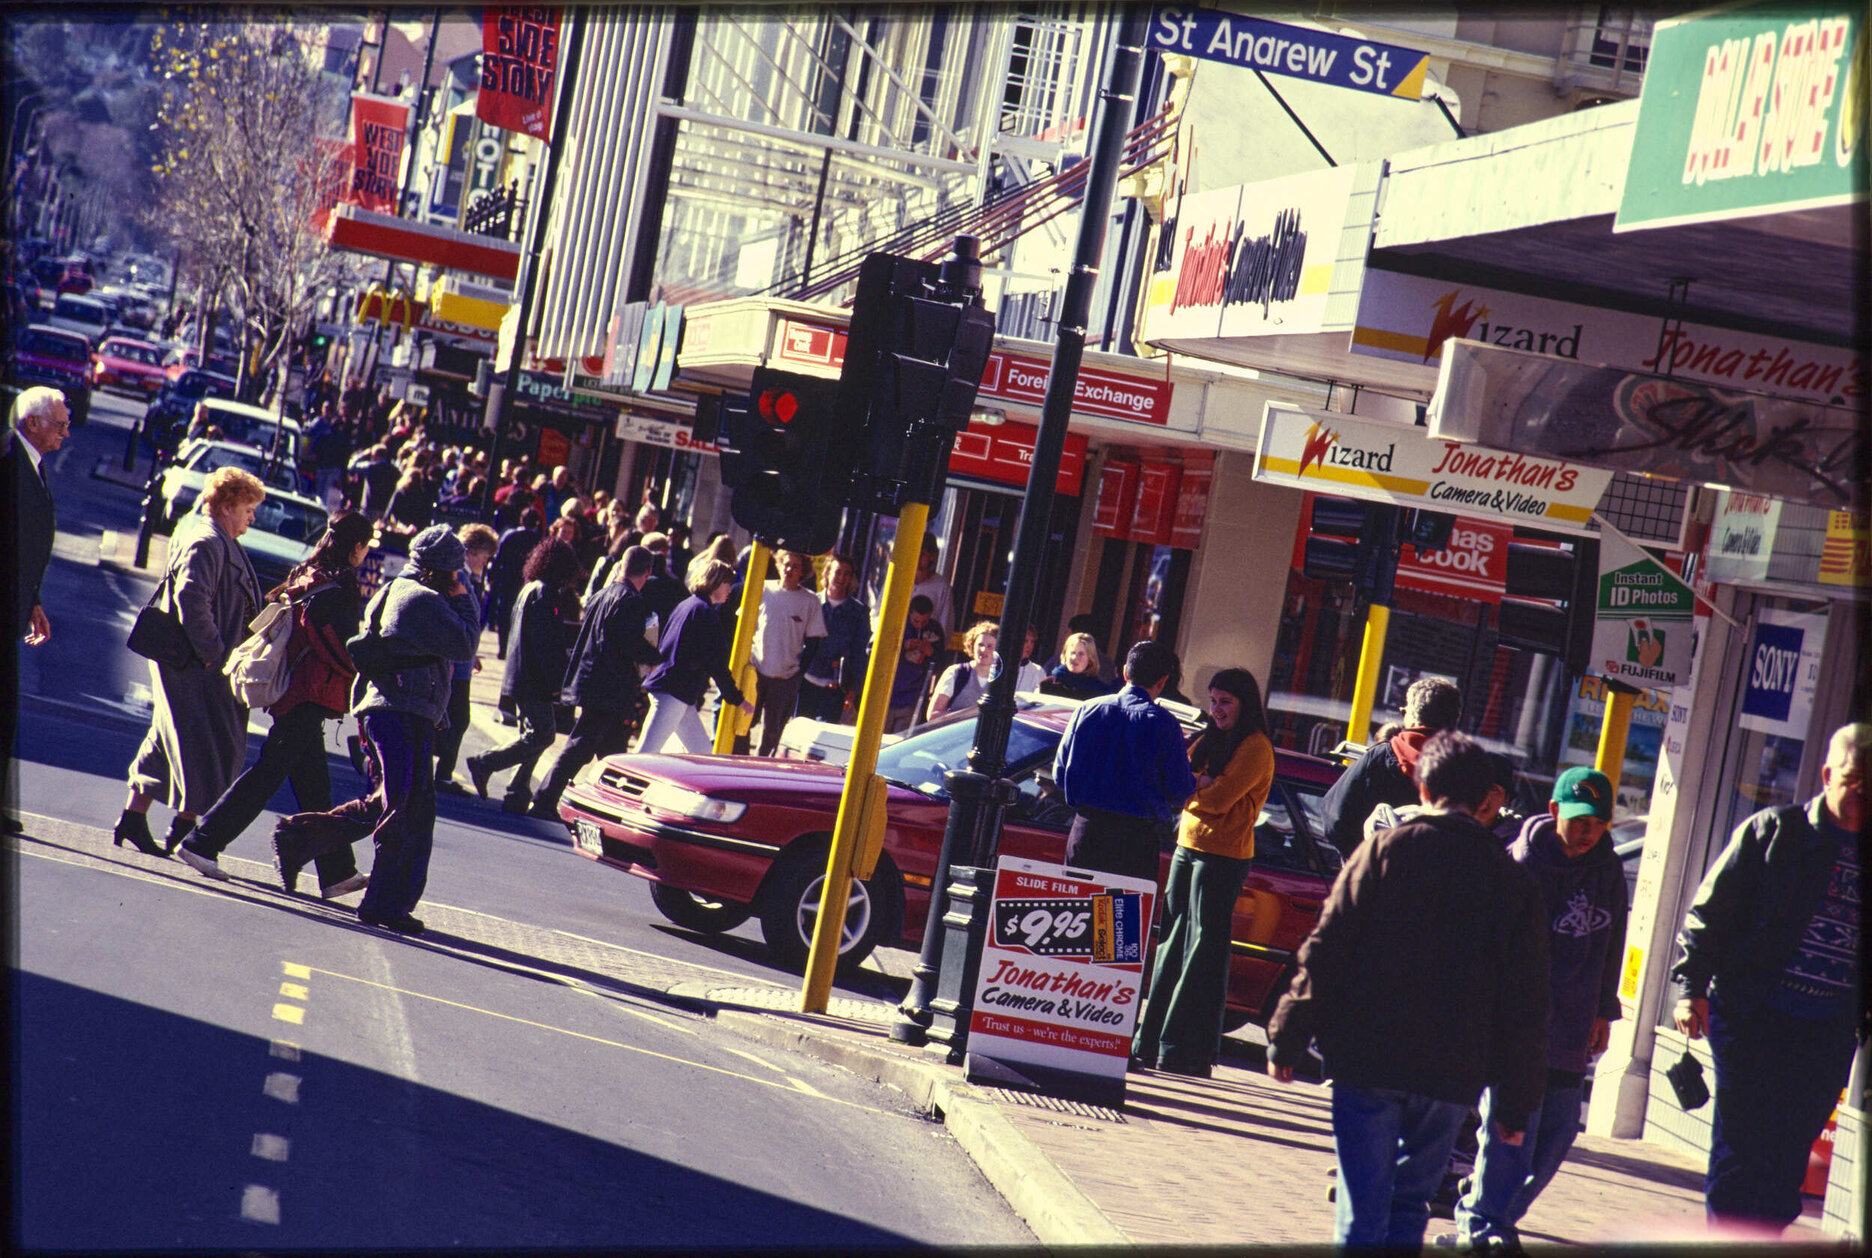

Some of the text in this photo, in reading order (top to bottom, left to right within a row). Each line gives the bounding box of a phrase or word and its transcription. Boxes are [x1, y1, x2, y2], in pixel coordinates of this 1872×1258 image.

[499, 15, 555, 67] SIDE
[1155, 7, 1197, 50] St
[1349, 45, 1391, 89] St
[482, 53, 553, 106] STORY
[364, 121, 403, 153] WEST
[367, 145, 399, 179] SIDE
[353, 168, 398, 203] STORY
[1074, 381, 1154, 410] Exchange
[1299, 420, 1579, 492] Wizard Jonathan's
[1614, 572, 1663, 585] Instant
[1610, 586, 1630, 607] ID
[1632, 589, 1678, 605] Photos
[1620, 664, 1676, 682] FUJIFILM
[1752, 643, 1798, 694] SONY
[1016, 876, 1078, 895] SLIDE FILM
[1004, 909, 1091, 947] $9.95
[1115, 920, 1124, 959] CHROME
[987, 960, 1136, 1005] Jonathan's
[1013, 1024, 1024, 1034] us
[1033, 1027, 1058, 1040] we're
[1060, 1030, 1077, 1043] the
